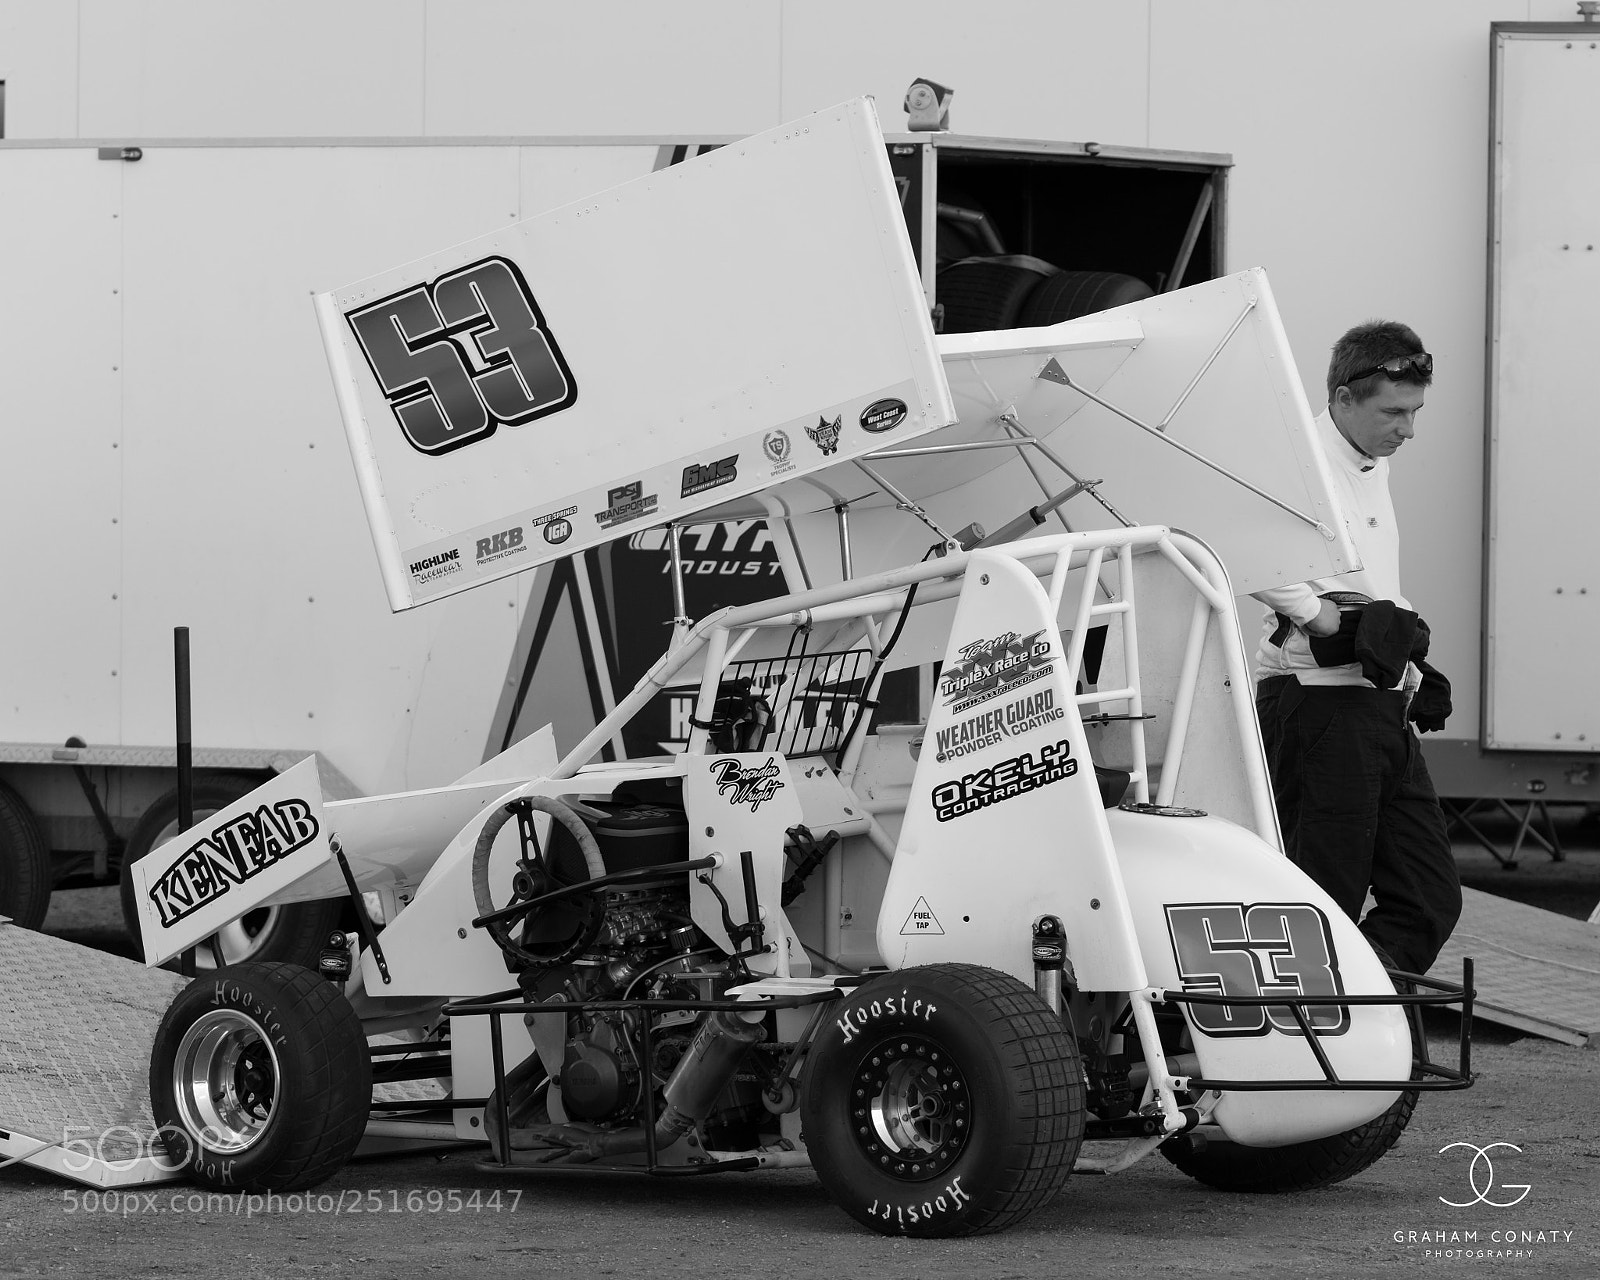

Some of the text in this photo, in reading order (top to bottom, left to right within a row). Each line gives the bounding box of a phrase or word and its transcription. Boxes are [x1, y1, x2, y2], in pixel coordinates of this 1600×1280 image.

[344, 255, 578, 457] 53
[769, 440, 783, 452] TS
[770, 464, 797, 477] SPECIALISTS
[532, 505, 578, 527] THREE SPRINGS
[594, 498, 650, 524] TRANSPORT
[476, 526, 524, 560] RKB
[547, 522, 568, 541] IGA
[409, 548, 460, 574] HIGHLINE
[412, 561, 463, 585] Racewear
[958, 631, 1021, 660] Team
[941, 641, 1051, 697] TripleX Race Co
[936, 688, 1054, 755] WEATHER GUARD
[946, 707, 1065, 761] POWDER COATING
[709, 756, 780, 786] Brendan
[933, 741, 1070, 809] OKELY
[718, 776, 785, 813] Wright
[938, 762, 1076, 820] CONTRACTING
[150, 799, 320, 929] KENFAB
[913, 911, 932, 920] FUEL
[915, 921, 930, 929] TAP
[1163, 902, 1352, 1038] 53
[210, 979, 288, 1046] Hoosier
[836, 989, 938, 1044] Hoosier
[866, 1174, 971, 1230] Hoosier
